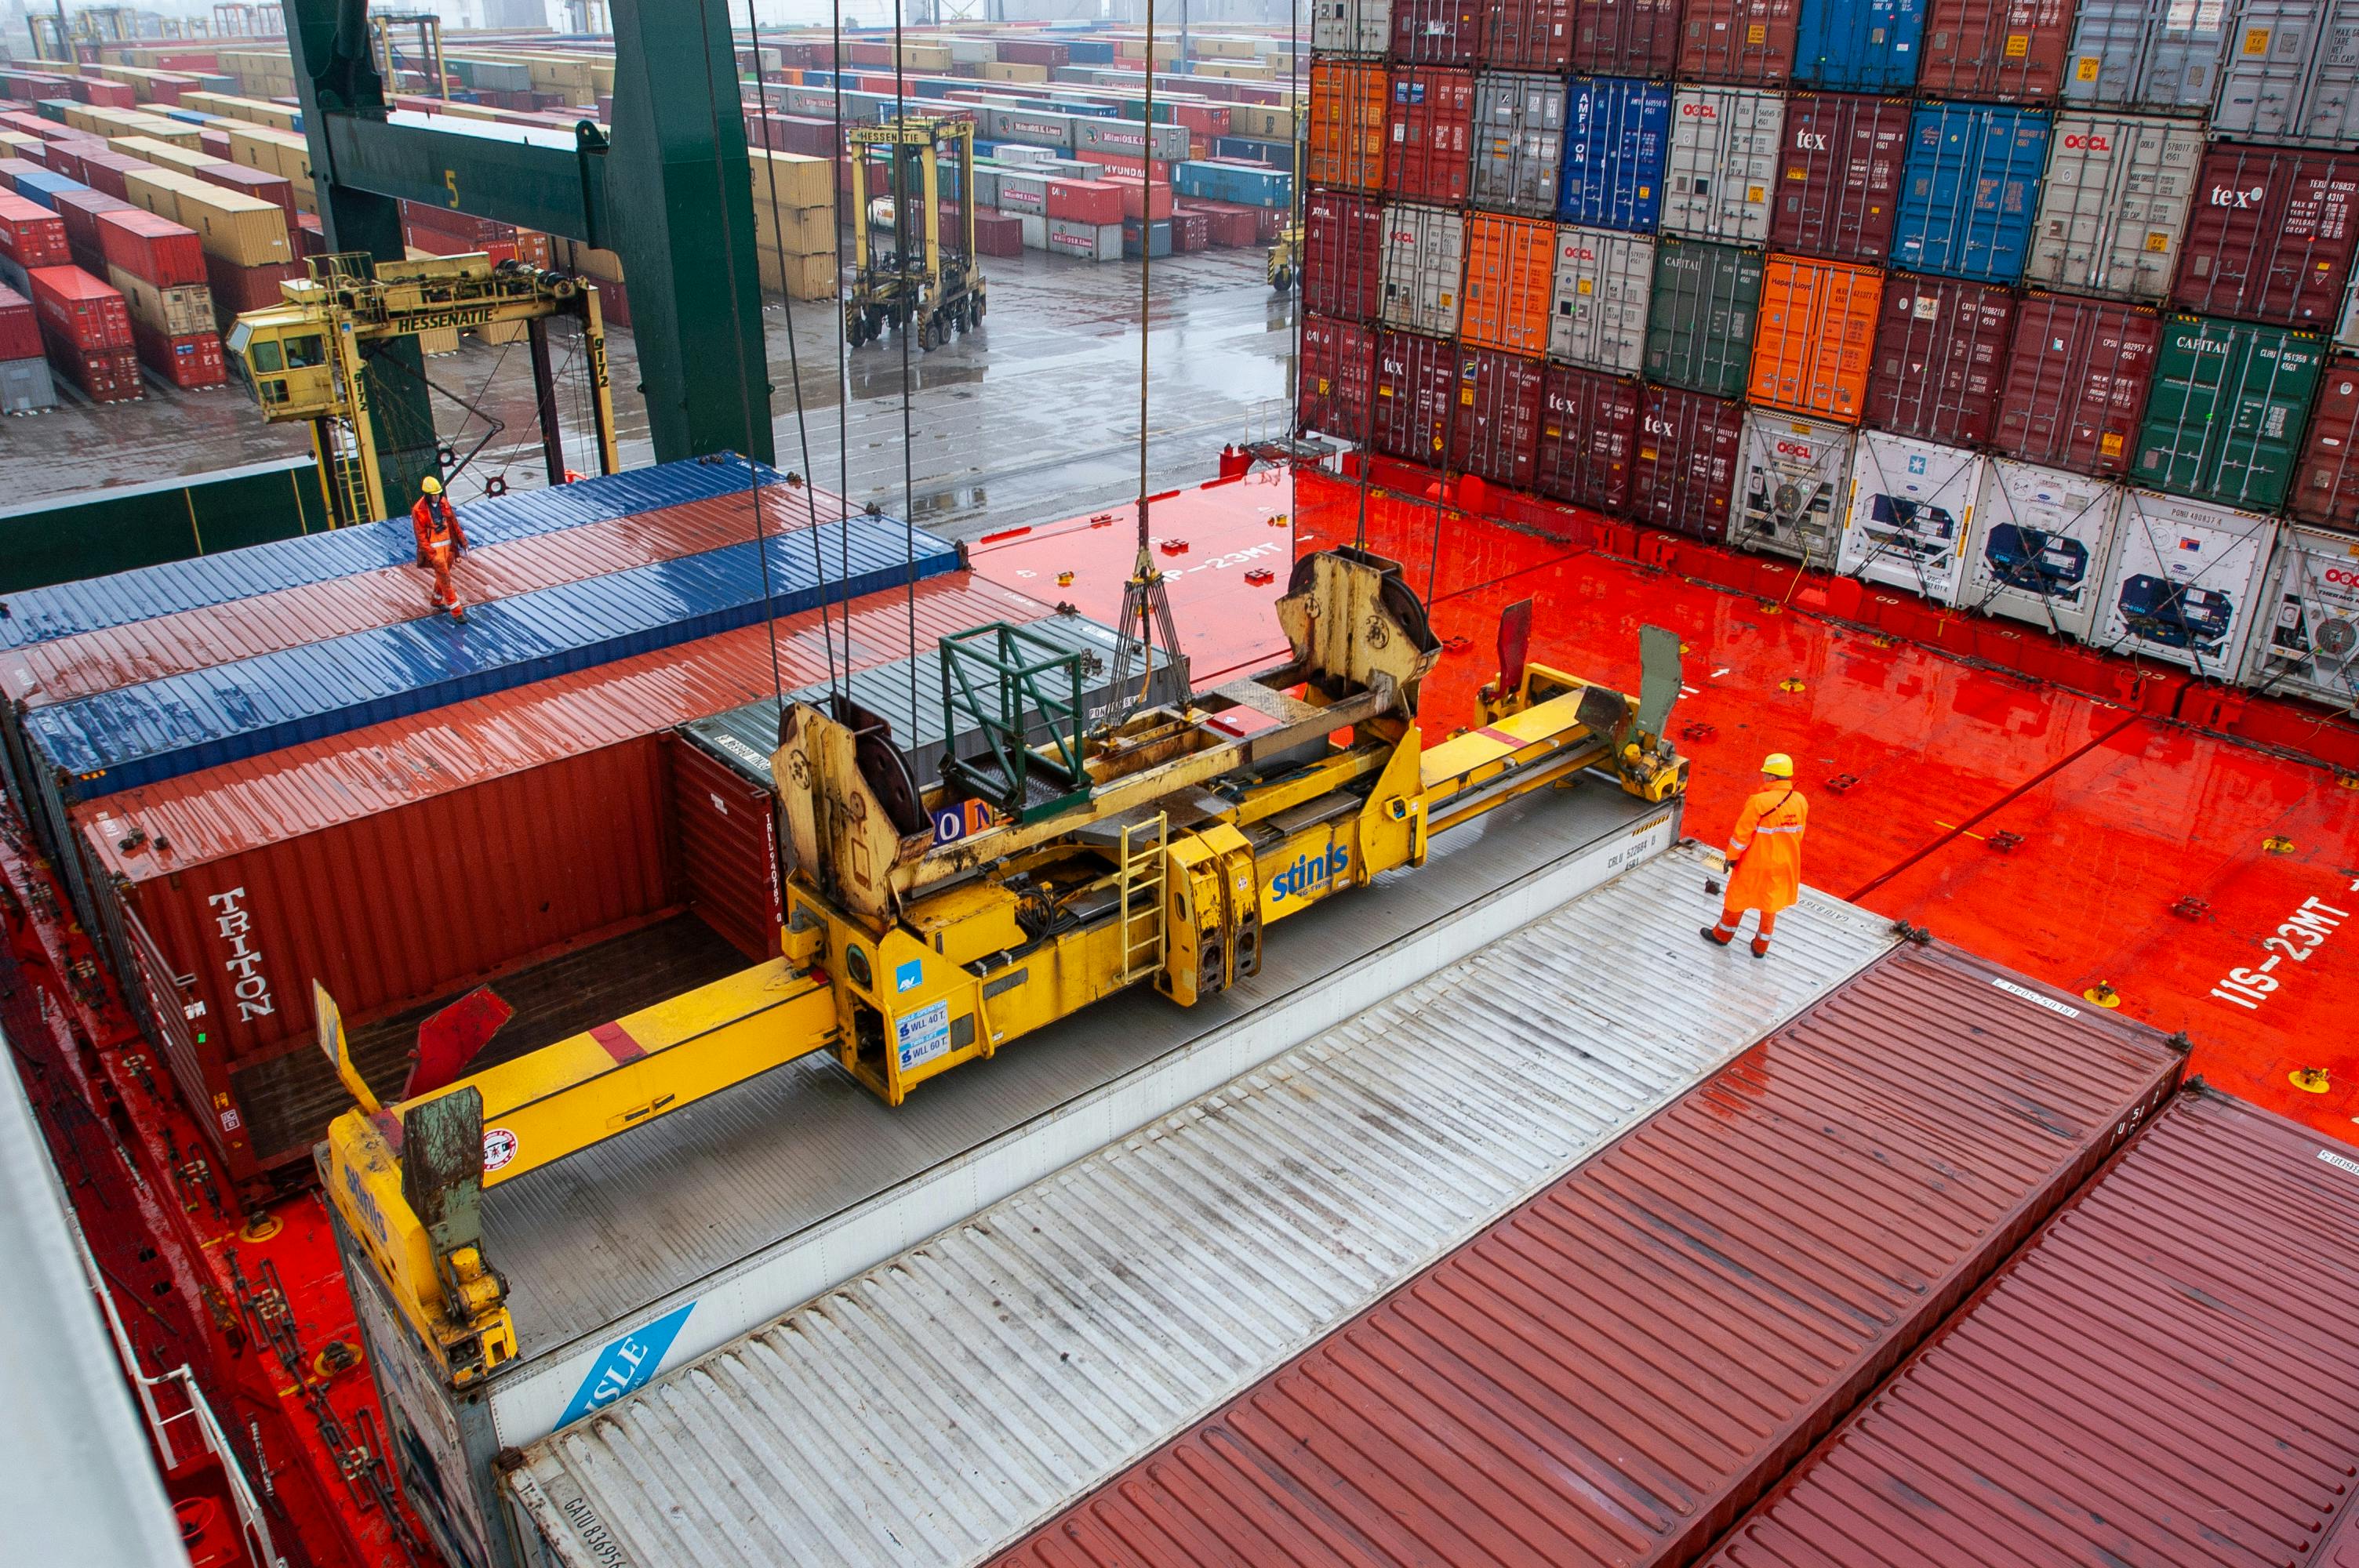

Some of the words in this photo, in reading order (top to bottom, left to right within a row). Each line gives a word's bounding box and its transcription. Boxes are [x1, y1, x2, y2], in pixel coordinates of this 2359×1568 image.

[860, 131, 918, 143] HESSENTIE
[1796, 127, 1826, 151] tex
[2064, 134, 2110, 151] OOCL
[445, 169, 460, 209] 5
[2211, 184, 2252, 209] tex
[2326, 193, 2345, 202] 4310
[398, 308, 494, 333] HESSENATIE
[1982, 316, 1996, 326] 4510
[596, 338, 609, 388] 9172
[353, 372, 368, 412] 9172
[1549, 392, 1575, 415] tex
[1645, 414, 1674, 437] tex
[1776, 441, 1812, 459] OOCL
[1761, 564, 1784, 572] 02
[1874, 595, 1899, 605] 00
[2318, 589, 2354, 602] THERMO
[1271, 840, 1349, 902] stinis
[208, 886, 275, 1023] TRITON
[911, 1018, 926, 1033] WLL
[928, 1013, 939, 1025] 40
[913, 1045, 929, 1059] WLL
[930, 1040, 940, 1051] 60
[564, 1497, 597, 1529] GATU
